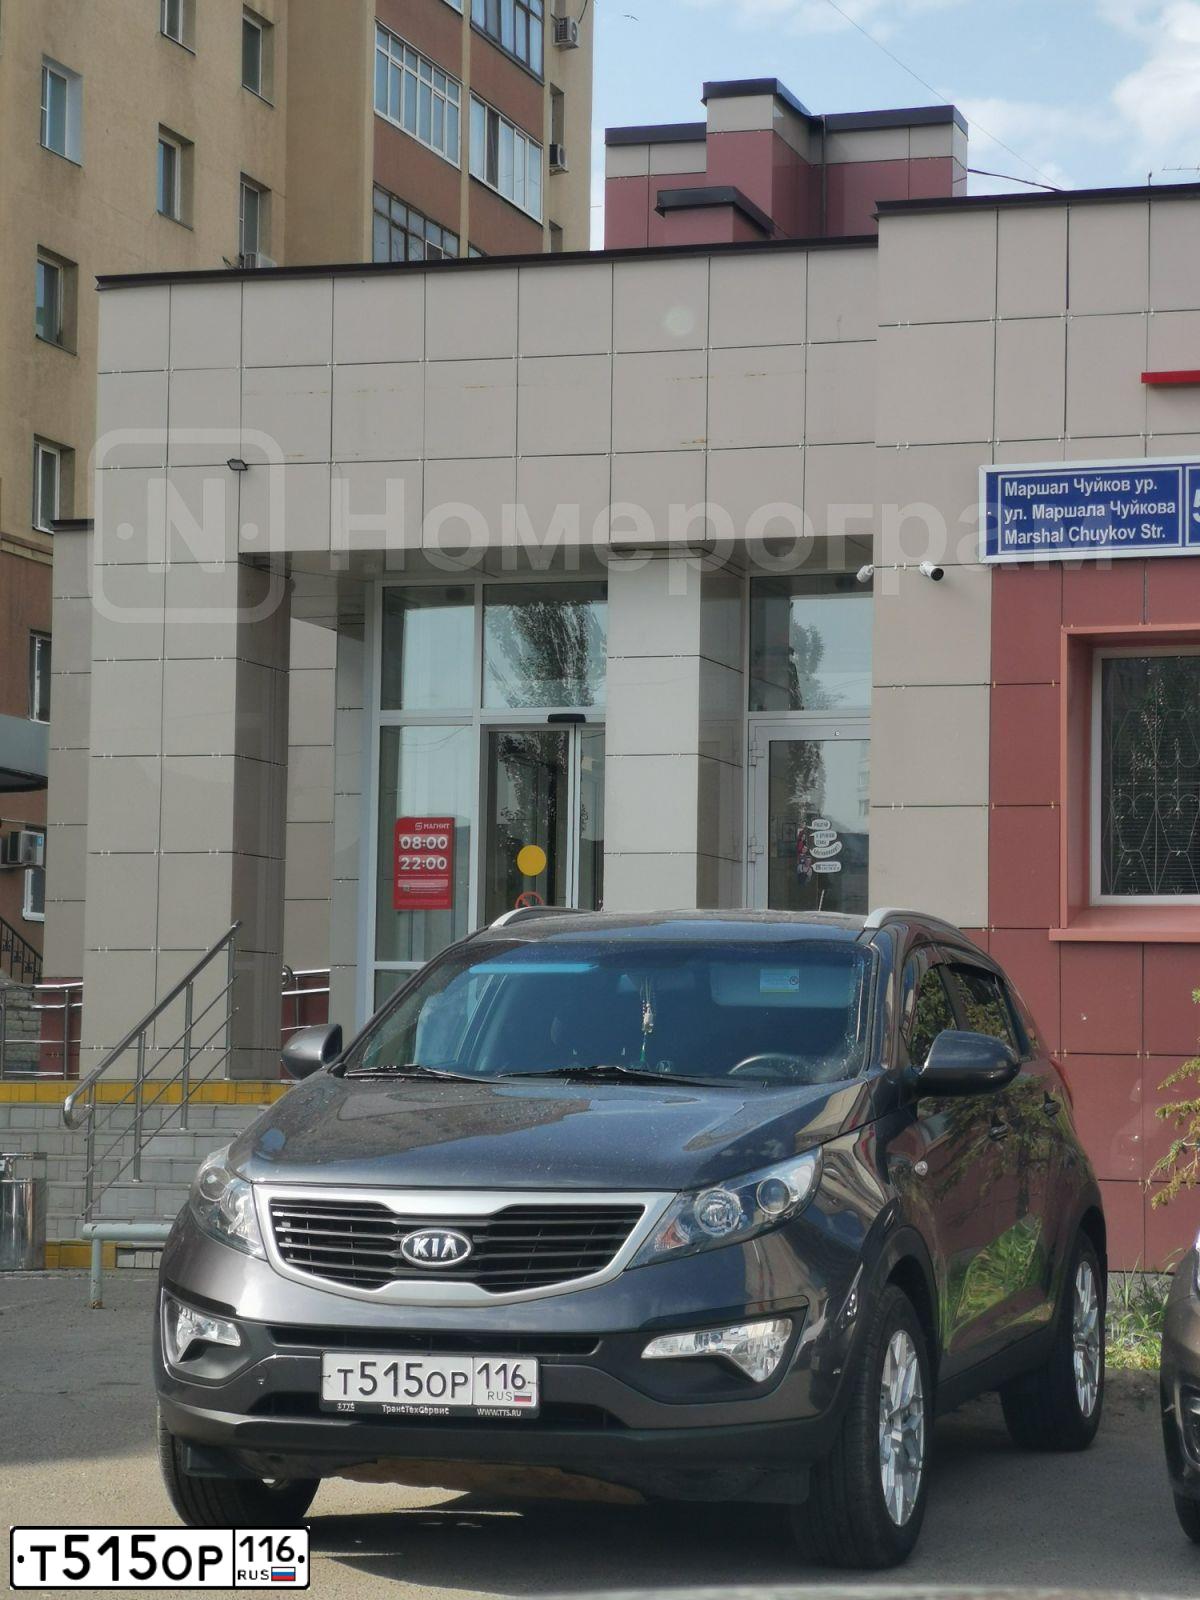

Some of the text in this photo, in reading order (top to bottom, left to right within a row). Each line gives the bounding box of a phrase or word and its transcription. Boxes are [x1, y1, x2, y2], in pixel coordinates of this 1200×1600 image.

[1005, 477, 1158, 499] Маршал Чуйков ур.
[1004, 507, 1027, 524] ул.
[1032, 502, 1105, 522] Маршала
[1110, 500, 1175, 518] Чуйкова
[1005, 523, 1166, 545] Marshal Chuykov Str.
[401, 836, 448, 850] 08:00
[401, 857, 447, 870] 22:00
[413, 1236, 458, 1258] KIA
[337, 1361, 468, 1398] Т515ОР
[476, 1362, 526, 1390] 116
[487, 1391, 513, 1402] RUS
